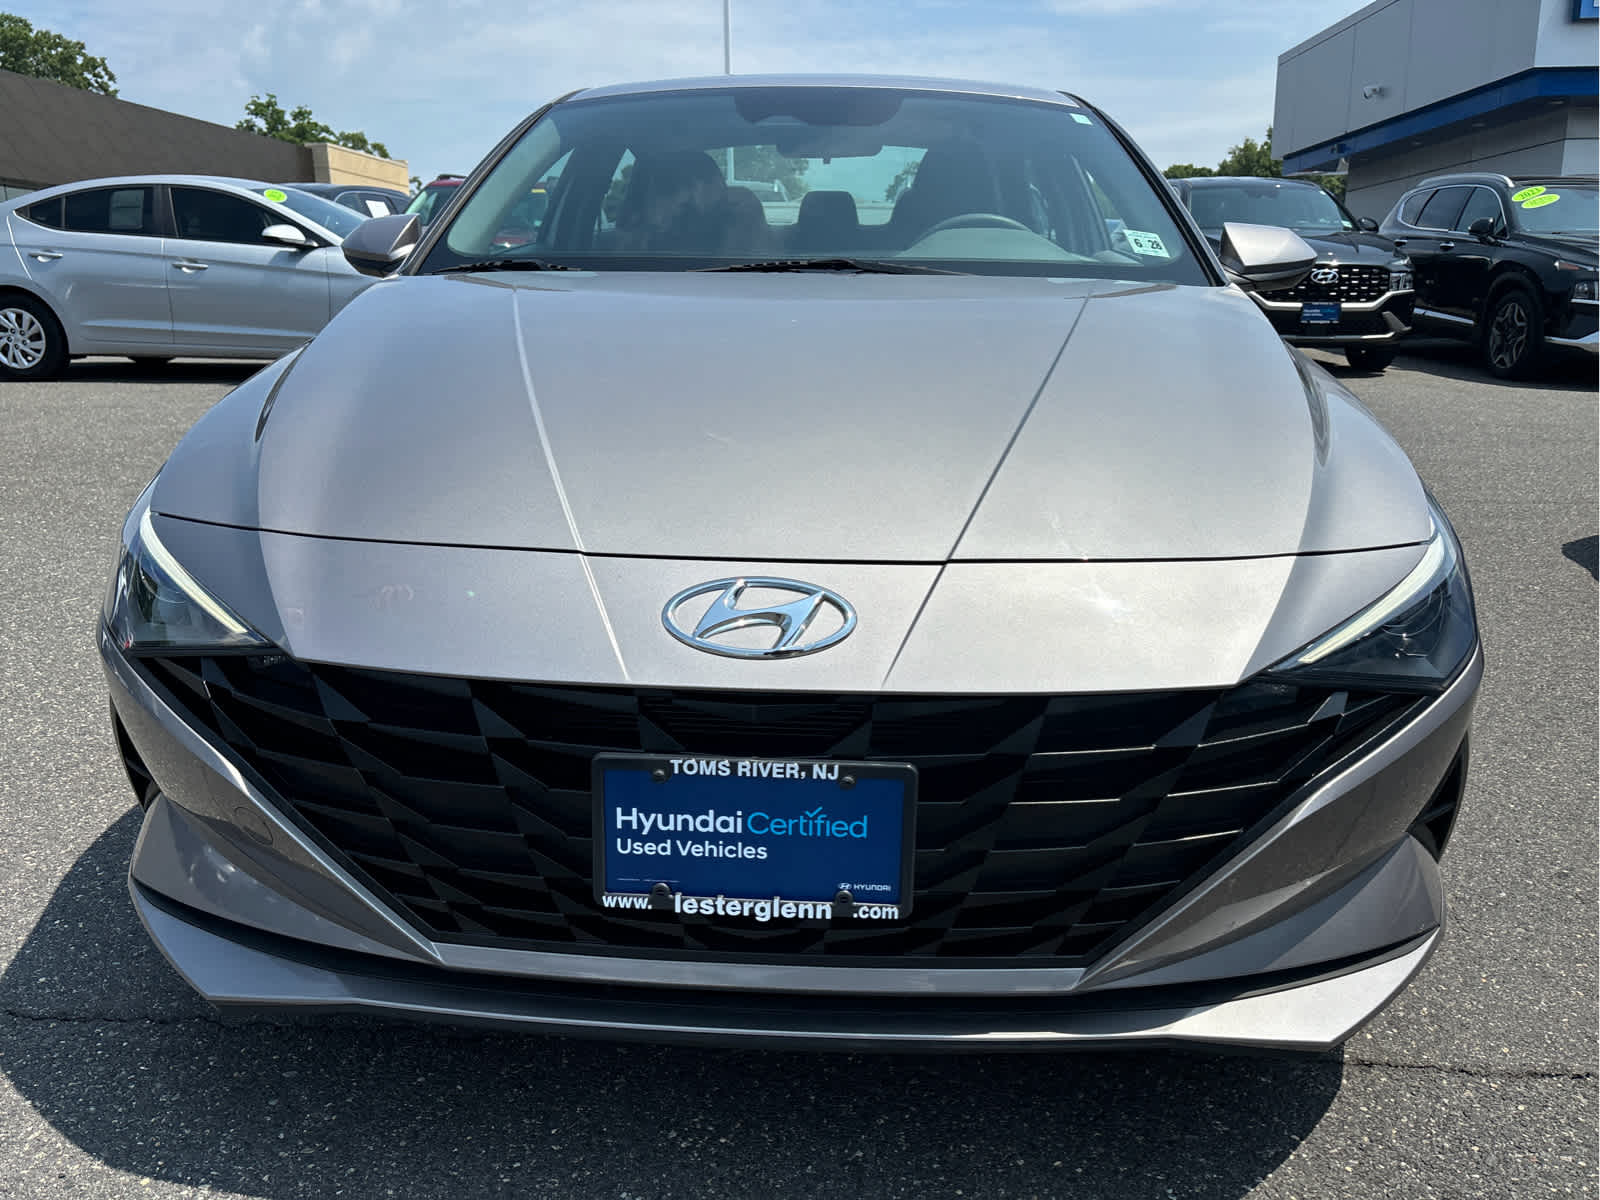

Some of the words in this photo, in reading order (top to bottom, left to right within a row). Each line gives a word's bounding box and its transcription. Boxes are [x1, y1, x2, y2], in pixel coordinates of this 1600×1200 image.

[1134, 238, 1143, 248] 6
[670, 758, 731, 776] TOMS
[737, 760, 806, 780] RIVER,
[812, 763, 839, 781] NJ
[616, 807, 743, 835] Hyundai
[747, 806, 869, 839] Certified
[616, 838, 672, 856] Used
[676, 840, 768, 859] Vehicles
[853, 883, 892, 892] HYUNDAI
[602, 895, 653, 910] www.
[674, 892, 832, 922] lesterglenn
[853, 905, 899, 920] .com
